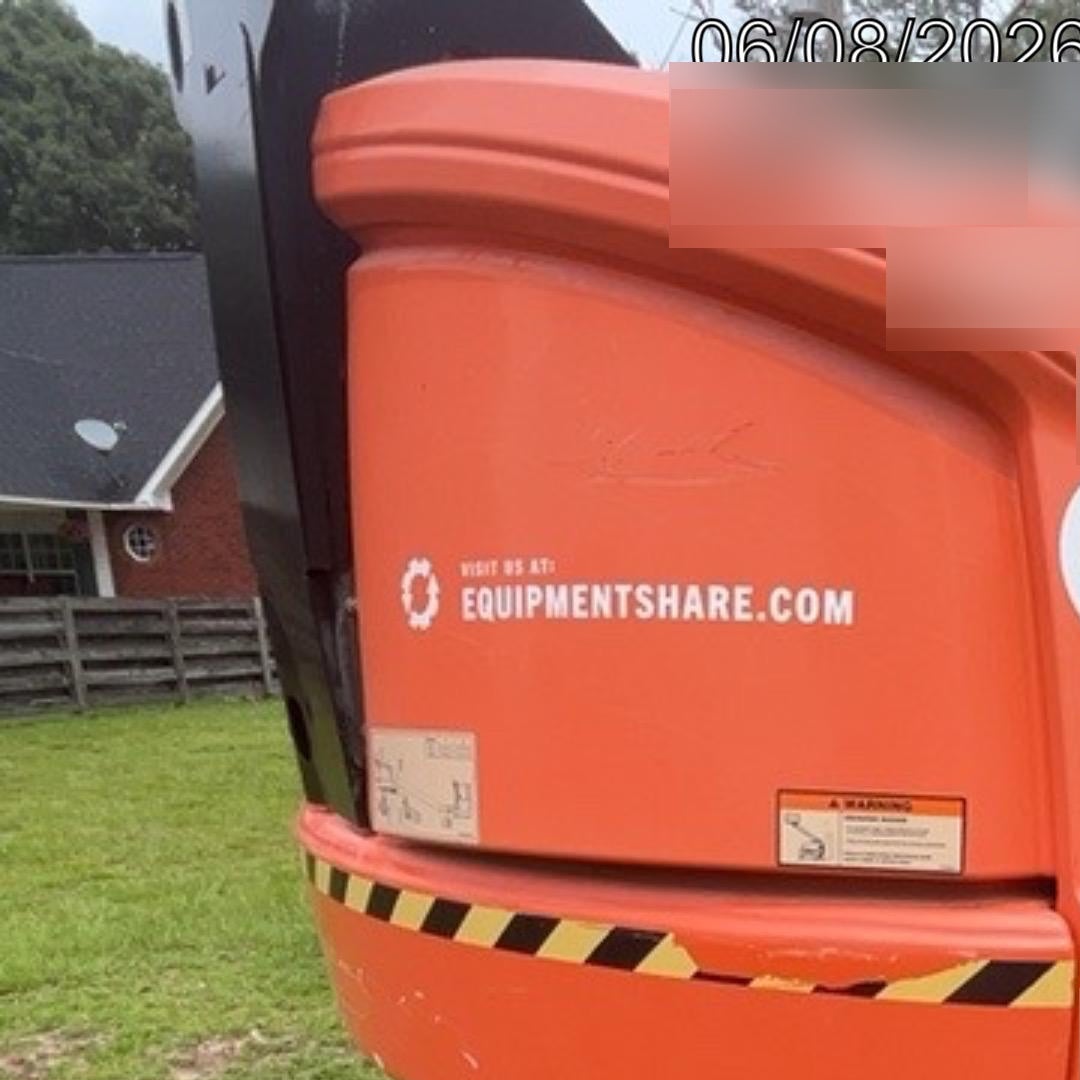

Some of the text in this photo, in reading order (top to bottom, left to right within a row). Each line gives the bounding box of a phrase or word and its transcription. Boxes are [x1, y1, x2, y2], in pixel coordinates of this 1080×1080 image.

[461, 559, 499, 577] VISIT
[502, 558, 524, 577] US
[461, 583, 855, 626] EQUIPMENTSHARE.COM
